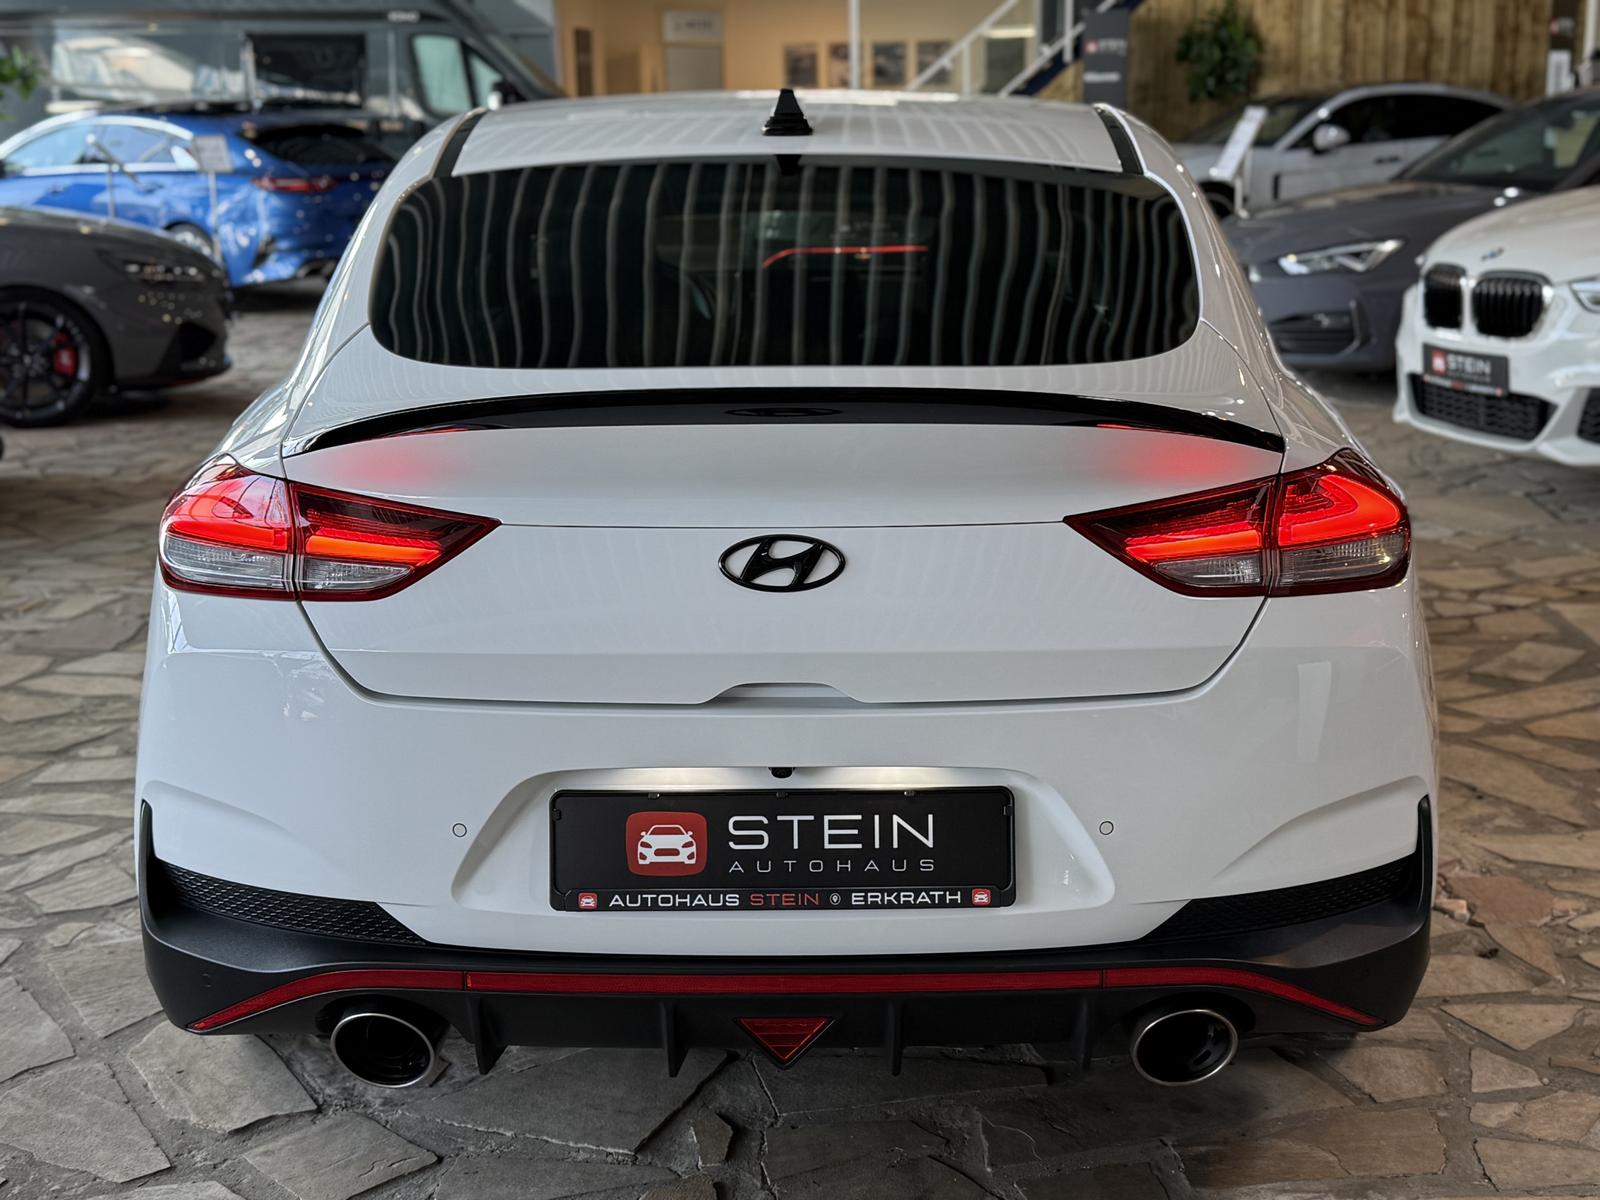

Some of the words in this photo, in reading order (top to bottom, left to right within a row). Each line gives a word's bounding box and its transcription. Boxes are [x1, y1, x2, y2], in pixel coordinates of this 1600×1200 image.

[1447, 354, 1491, 375] STEIN
[728, 814, 934, 850] STEIN
[728, 859, 934, 873] AUTOHAUS
[608, 893, 740, 907] AUTOHAUS
[750, 893, 819, 906] STEIN
[851, 890, 961, 905] ERKRATH
